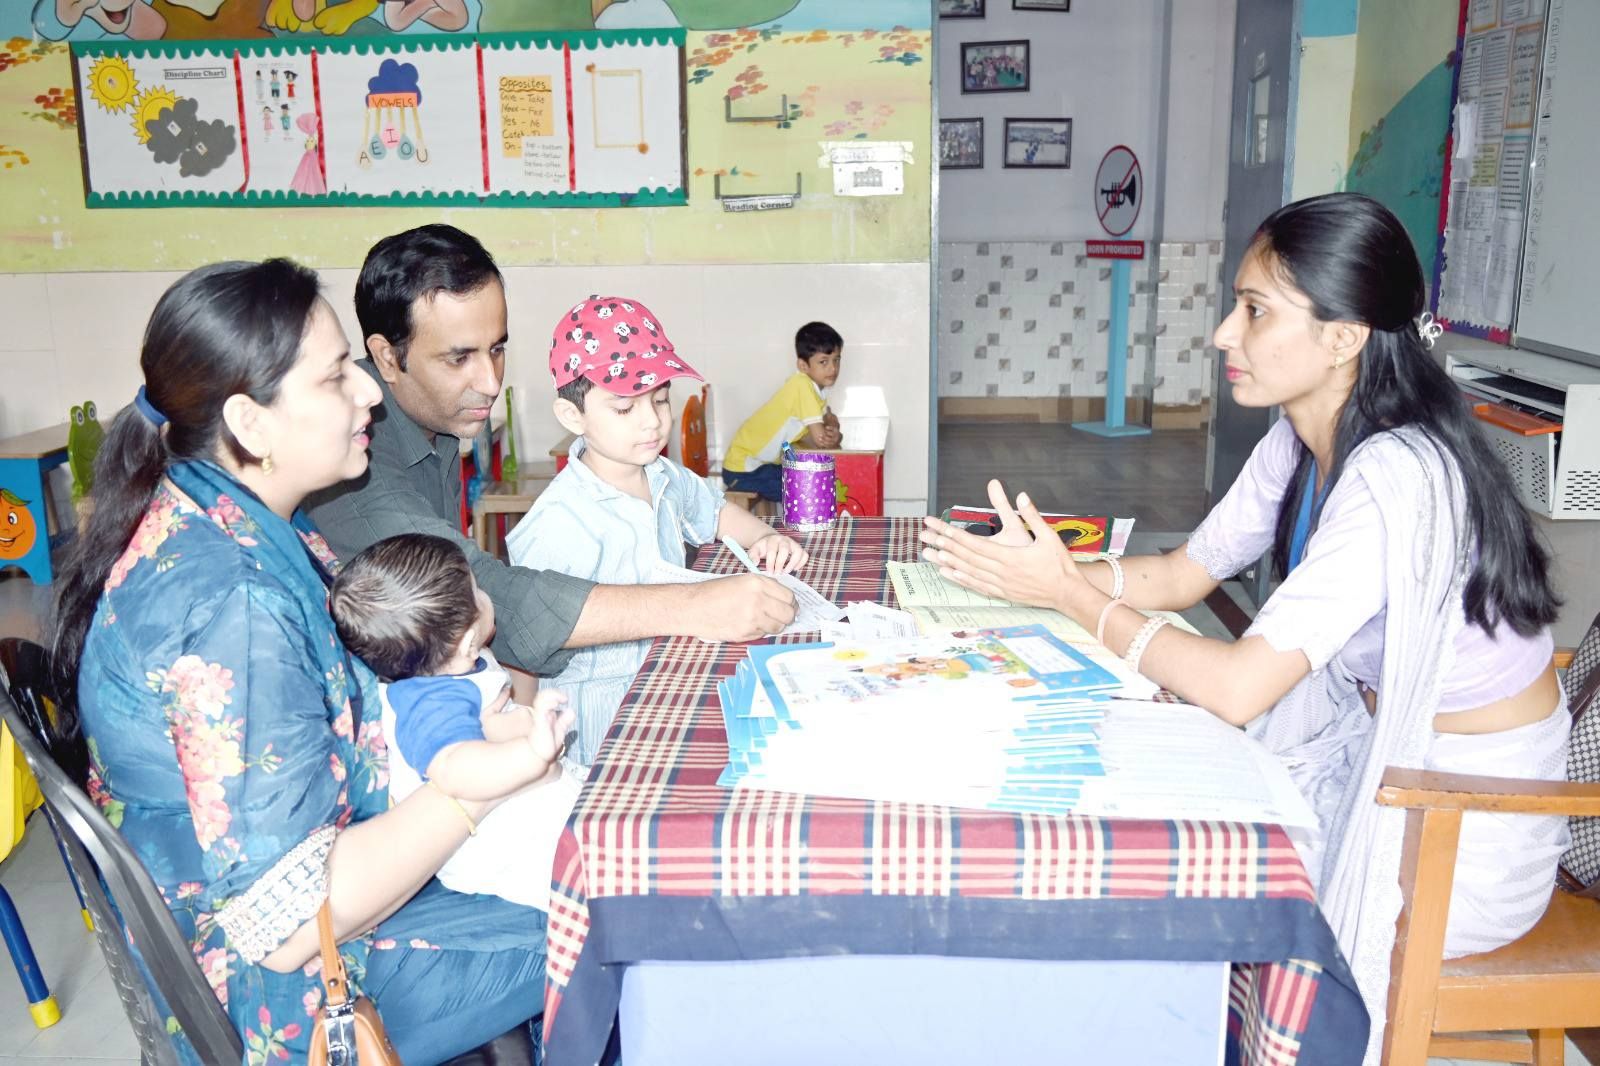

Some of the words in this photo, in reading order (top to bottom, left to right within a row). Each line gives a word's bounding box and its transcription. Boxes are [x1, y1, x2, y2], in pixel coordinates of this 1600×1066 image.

[165, 70, 202, 79] Discipline
[500, 76, 546, 89] Opposites
[372, 97, 414, 108] VOWELS
[359, 151, 370, 165] A
[371, 141, 382, 156] E
[385, 128, 398, 144] I
[400, 141, 412, 156] O
[416, 148, 428, 163] U
[1088, 244, 1104, 254] HORN
[1105, 245, 1143, 255] PROHIBITED
